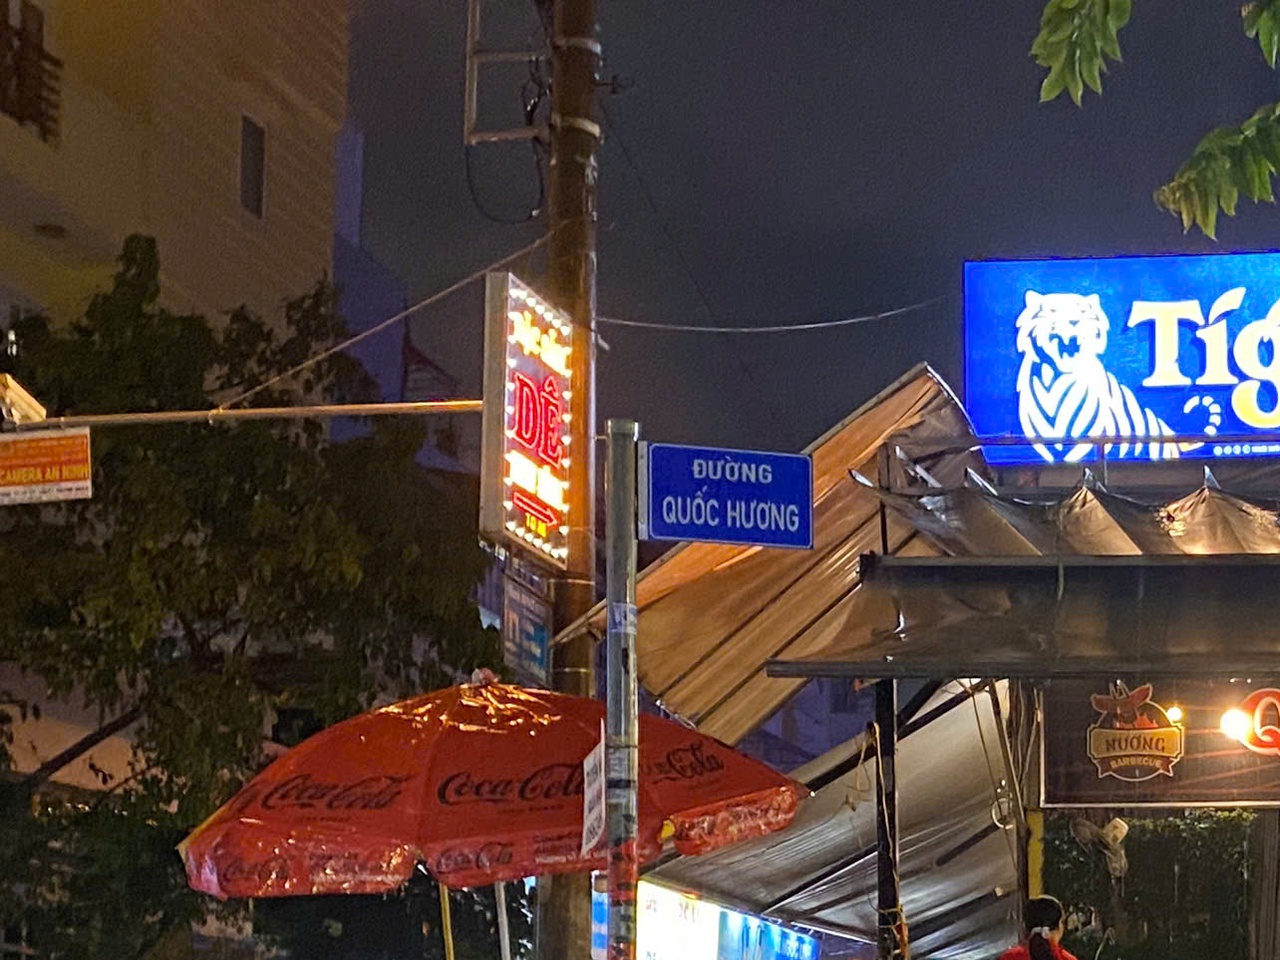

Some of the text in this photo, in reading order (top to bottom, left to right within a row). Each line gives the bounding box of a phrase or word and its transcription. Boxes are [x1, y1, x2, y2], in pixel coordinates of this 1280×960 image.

[515, 373, 563, 468] DÊ
[692, 459, 773, 483] ĐƯỜNG
[662, 486, 799, 532] QUỐC HƯƠNG
[437, 762, 584, 806] Coca-Col
